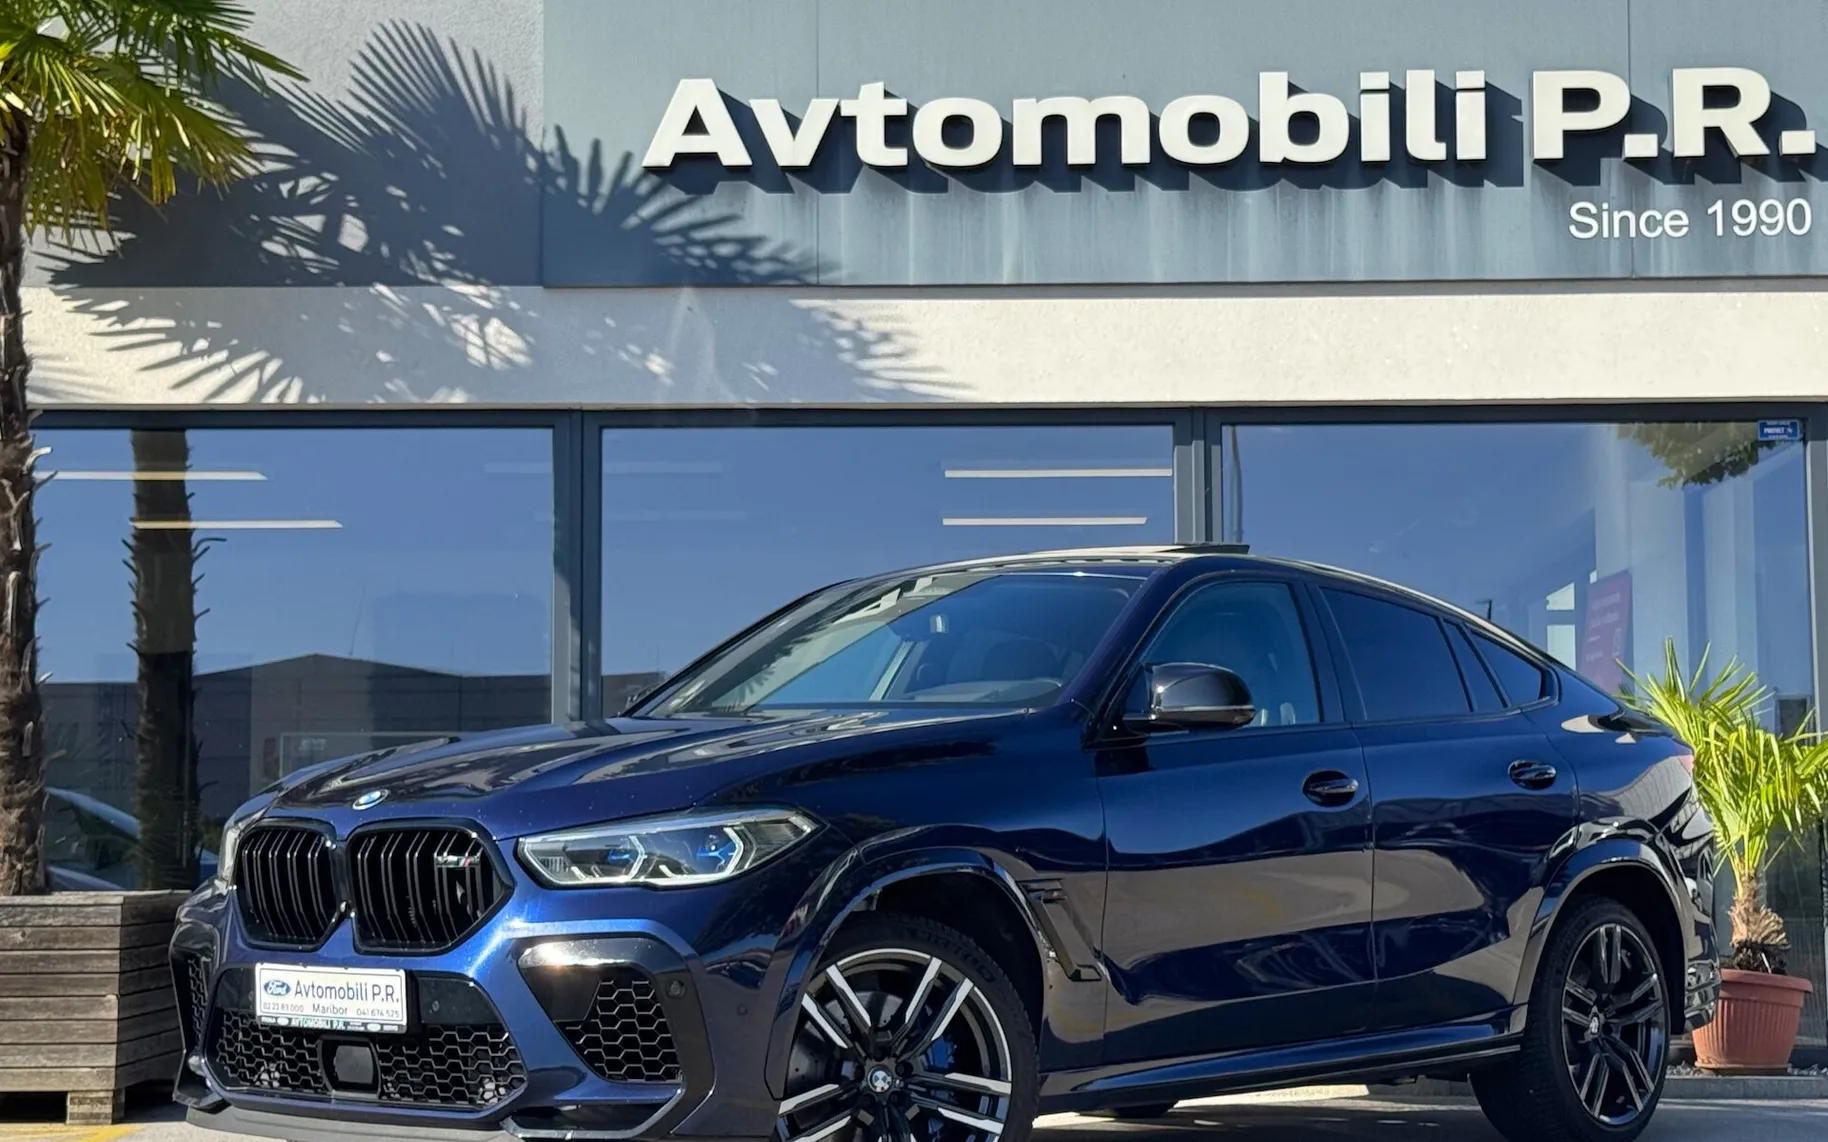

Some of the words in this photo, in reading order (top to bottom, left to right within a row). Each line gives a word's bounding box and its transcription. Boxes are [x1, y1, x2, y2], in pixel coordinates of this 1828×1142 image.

[641, 69, 1486, 168] Avtomobili
[1531, 66, 1817, 161] P.R.
[1568, 201, 1690, 239] Since
[1706, 197, 1813, 237] 1990
[294, 979, 368, 1002] Avtomobili
[371, 984, 400, 1003] P.R.
[312, 1003, 348, 1015] Maribor
